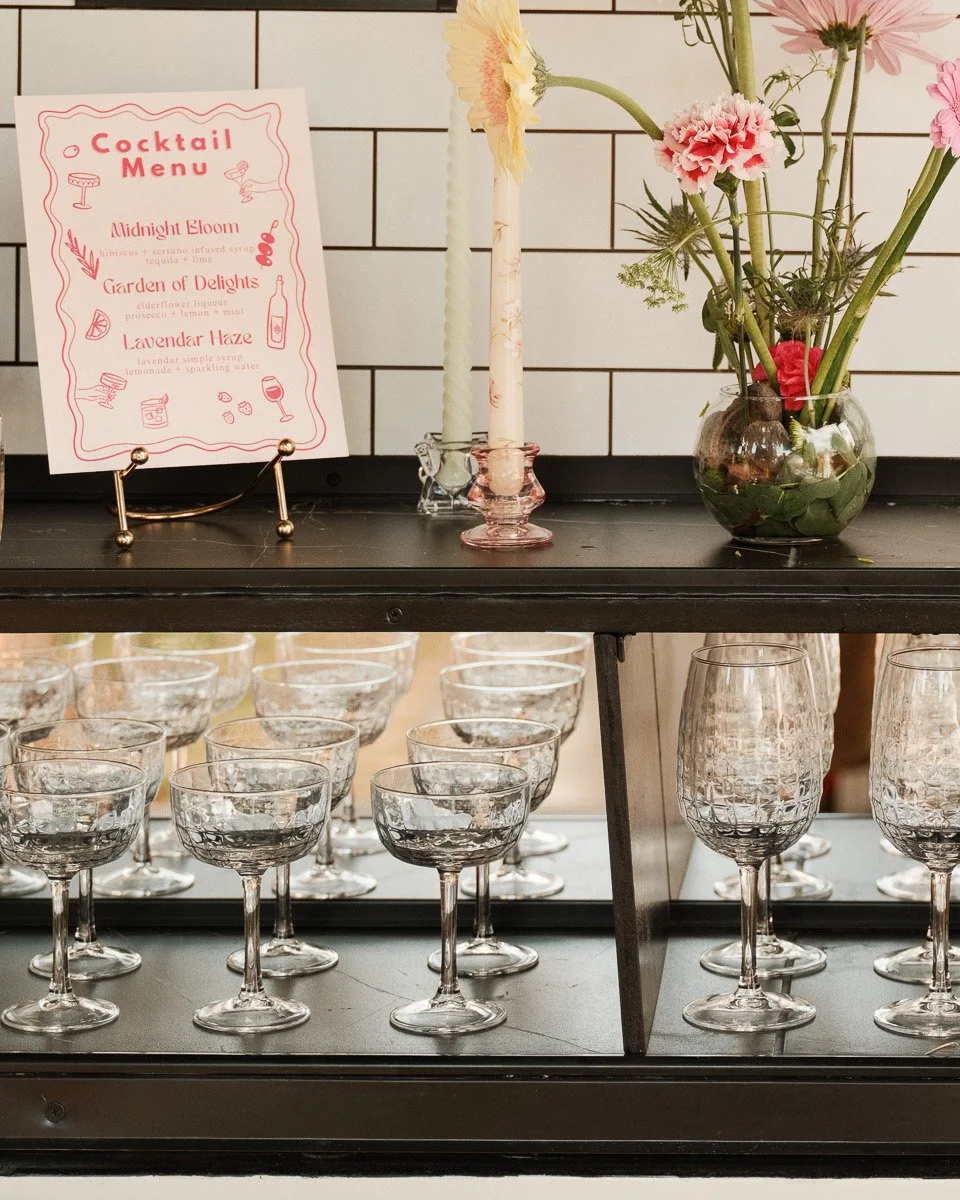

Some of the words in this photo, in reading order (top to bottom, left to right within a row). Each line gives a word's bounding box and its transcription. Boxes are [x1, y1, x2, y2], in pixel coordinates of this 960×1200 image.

[91, 128, 232, 154] Cocktail
[121, 156, 208, 178] Menu
[111, 221, 180, 240] Midnight
[186, 219, 240, 235] Bloom
[99, 248, 139, 257] hibiscus
[152, 247, 188, 255] serrano
[191, 245, 226, 254] infused
[229, 245, 255, 254] syrup
[145, 257, 179, 266] tequila
[192, 256, 213, 264] lime
[103, 277, 166, 294] Garden
[172, 275, 188, 292] of
[194, 274, 260, 294] Delights
[136, 300, 190, 310] elderflower
[194, 299, 229, 309] liqueur
[125, 311, 167, 321] prosecco
[180, 309, 210, 318] lemon
[223, 308, 244, 316] mint
[123, 331, 204, 350] Lavendar
[210, 329, 253, 346] Haze
[137, 356, 179, 366] lavendar
[182, 354, 214, 365] simple
[216, 354, 244, 363] syrup
[125, 366, 172, 376] lemonade
[185, 364, 231, 375] sparkling
[234, 362, 260, 371] water
